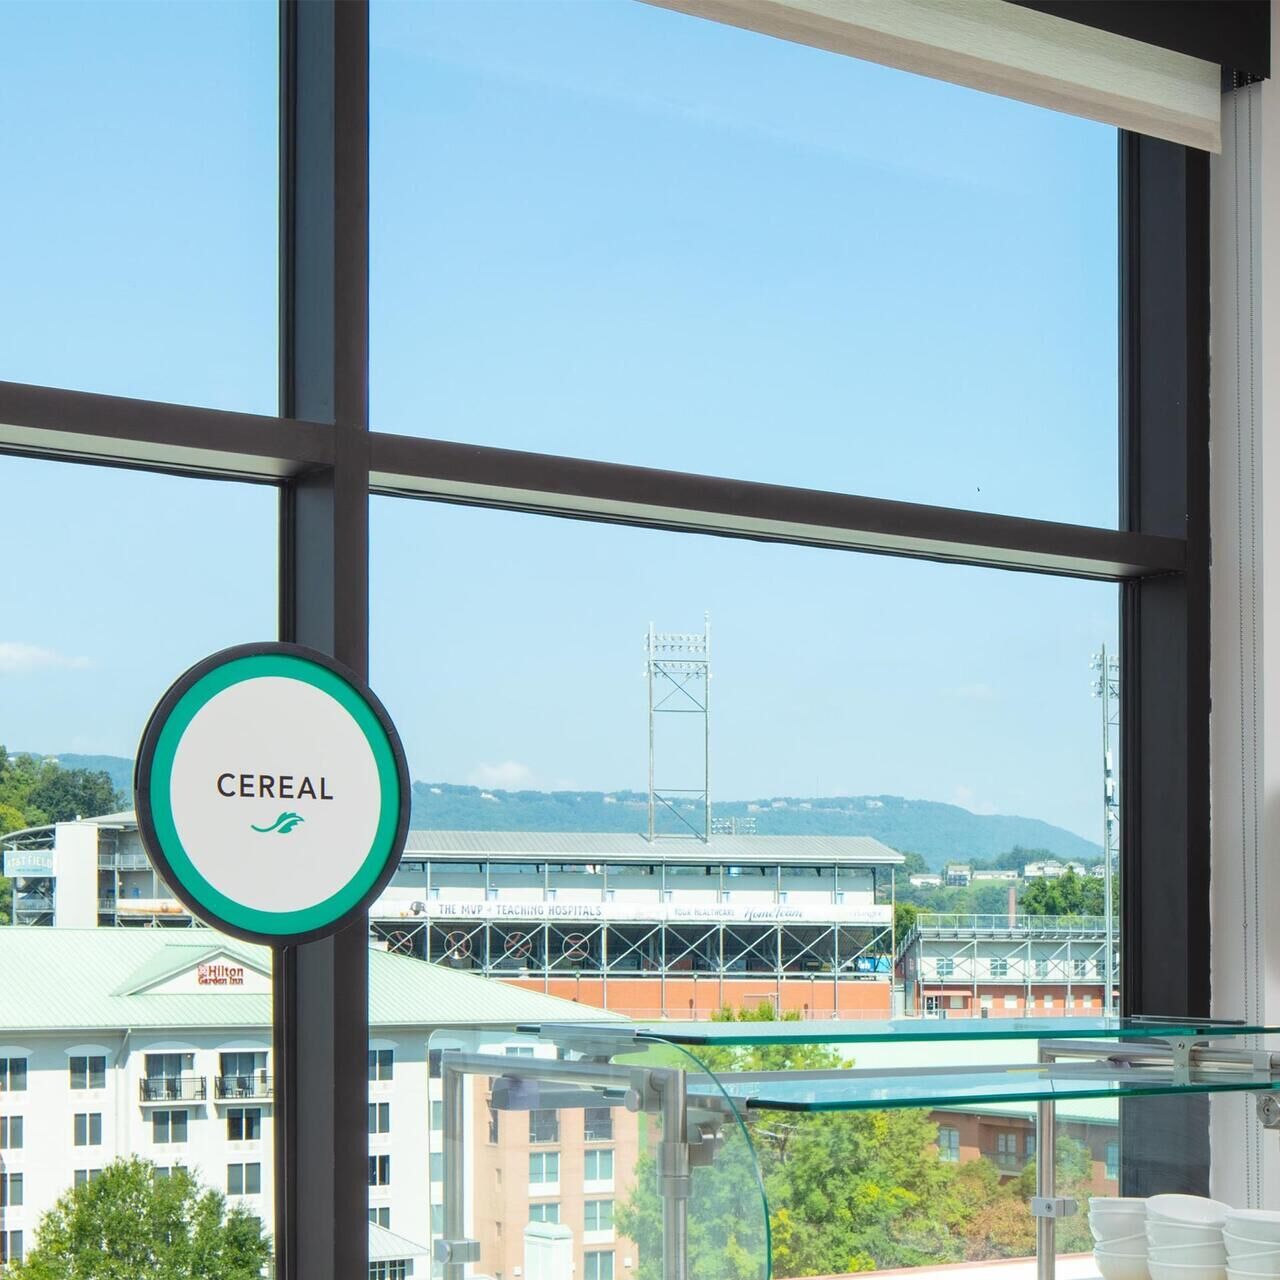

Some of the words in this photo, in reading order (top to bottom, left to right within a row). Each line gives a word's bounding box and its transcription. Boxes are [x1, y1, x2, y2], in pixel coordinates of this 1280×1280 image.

[217, 772, 334, 801] CEREAL
[439, 904, 457, 915] THE
[461, 904, 483, 915] MVP
[496, 904, 544, 916] TEACHING
[548, 904, 602, 916] HOSPITALS
[208, 965, 244, 977] Hilton
[198, 976, 227, 986] Garden
[229, 976, 243, 986] Inn
